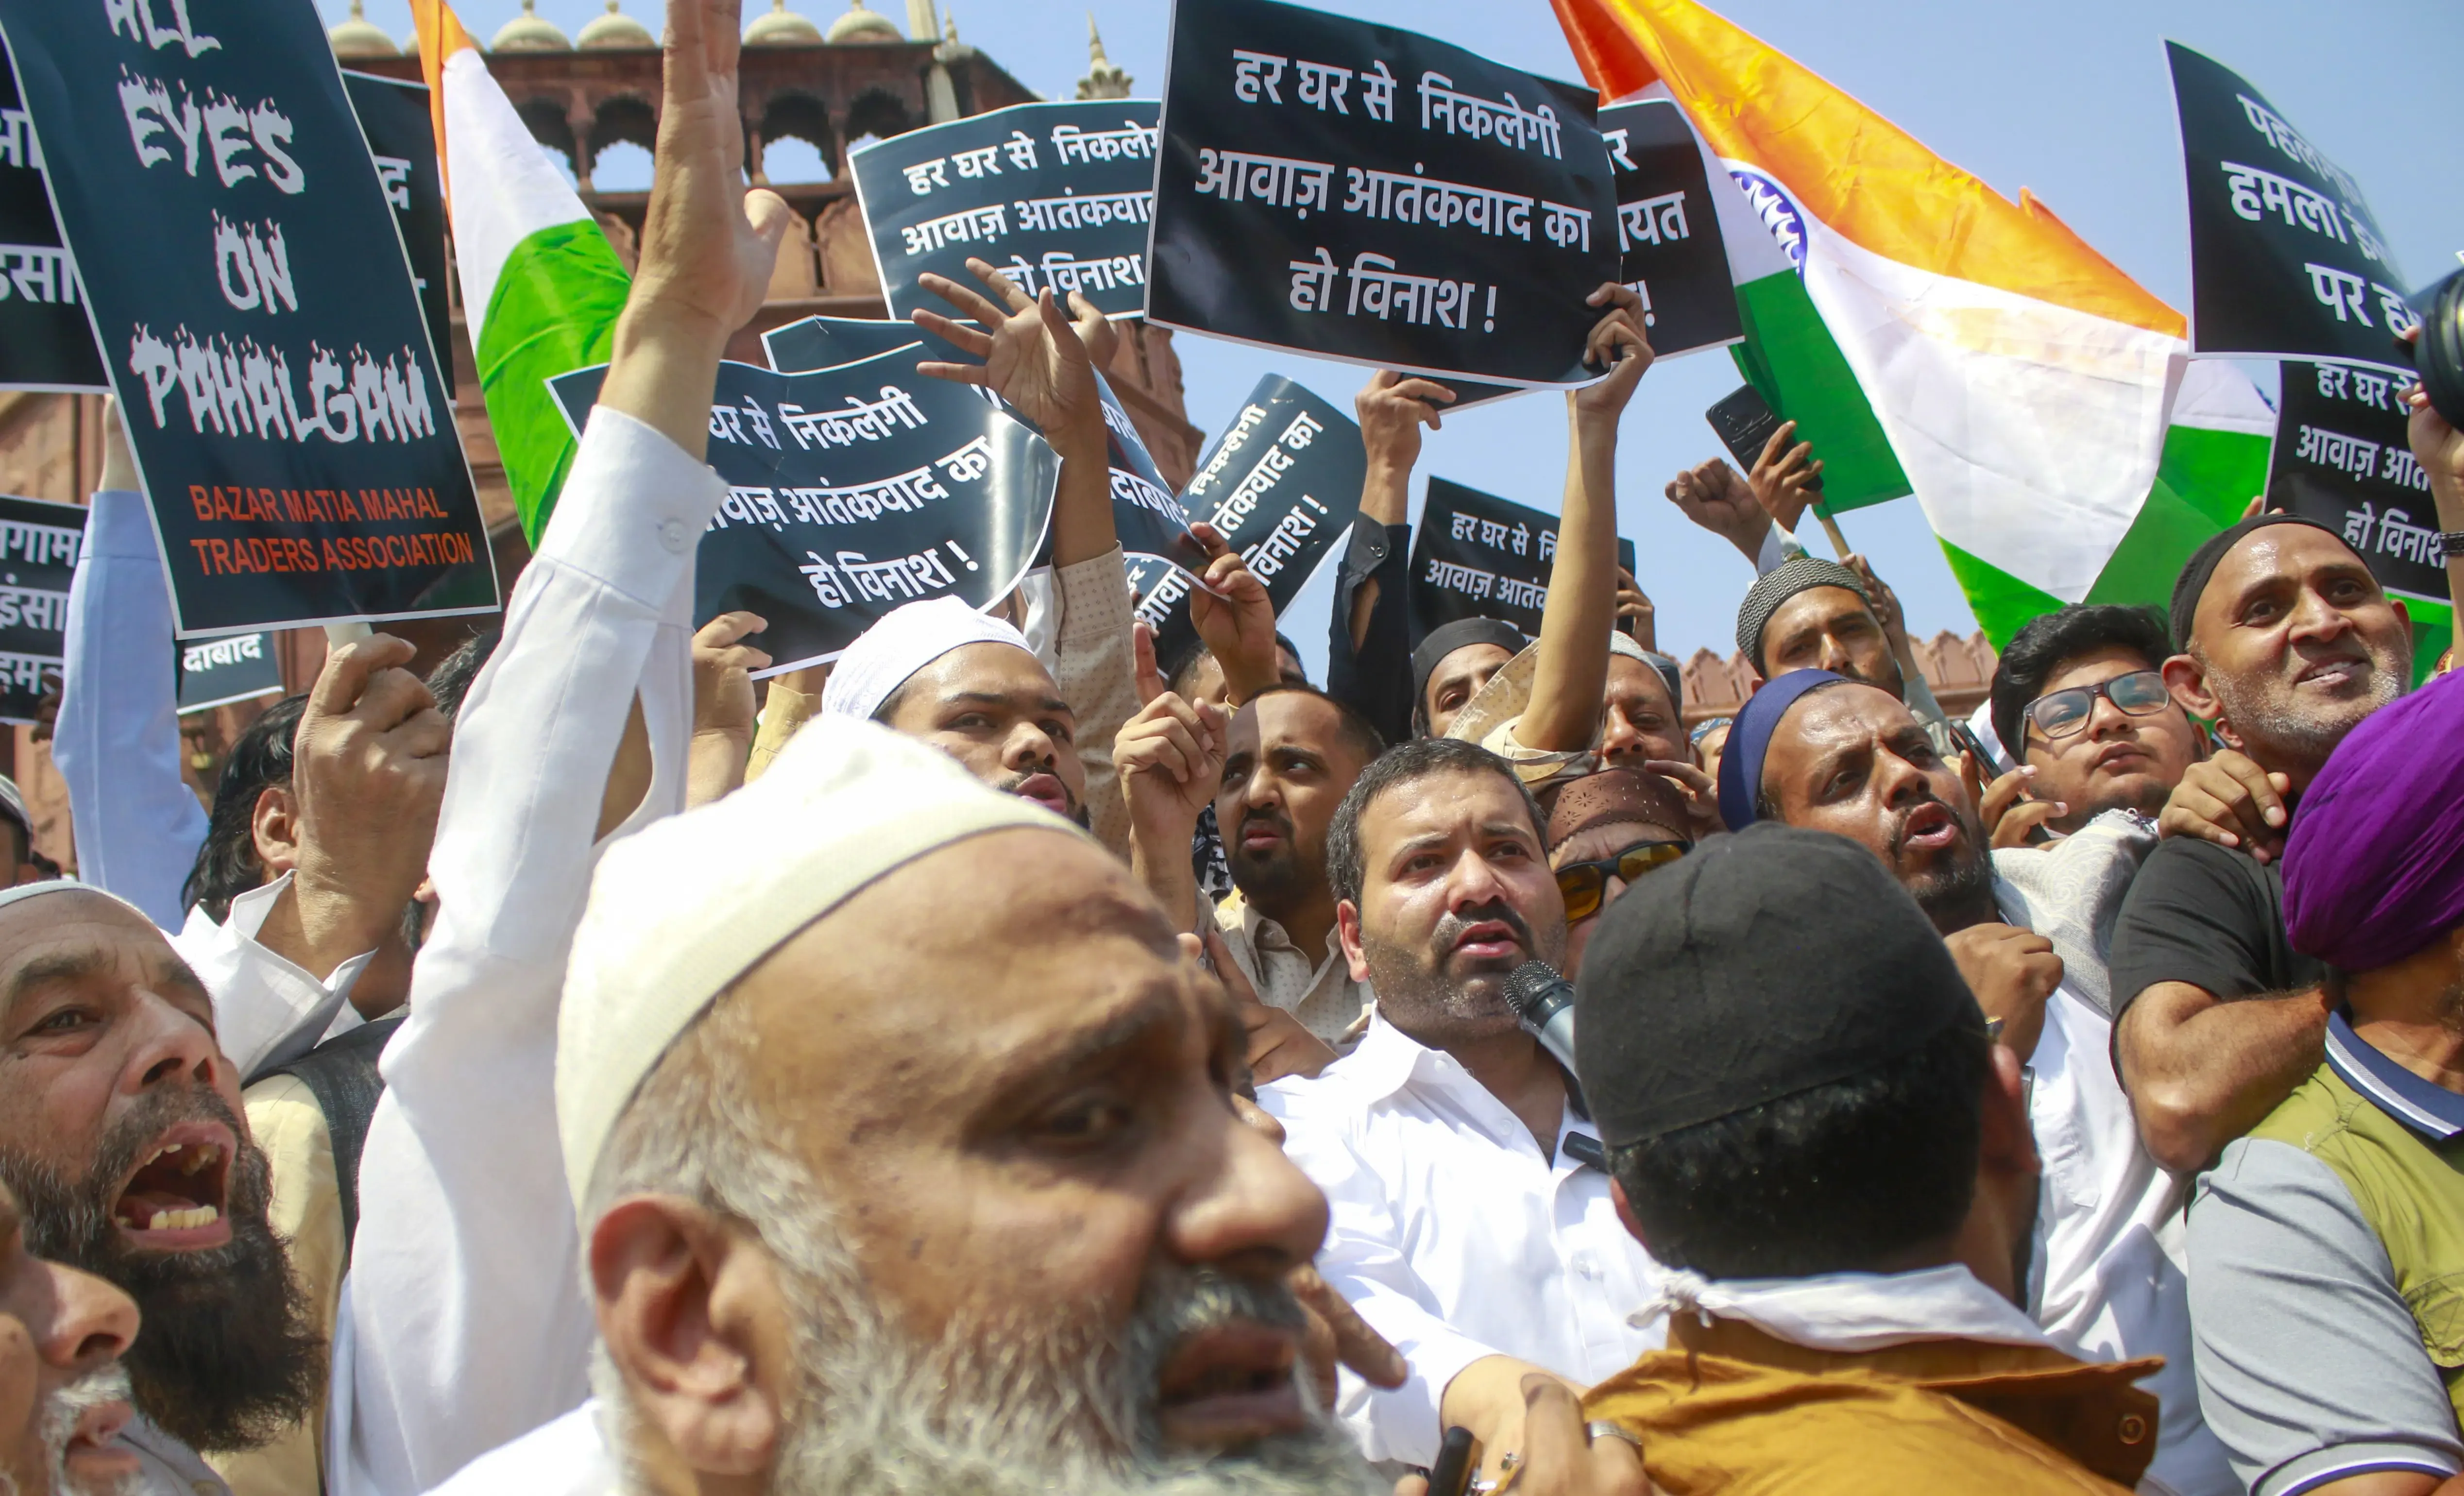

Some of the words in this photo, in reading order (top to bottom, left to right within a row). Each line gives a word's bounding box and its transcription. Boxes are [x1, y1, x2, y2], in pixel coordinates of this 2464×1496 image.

[118, 63, 305, 194] EYES
[1233, 49, 1287, 104] हर
[1296, 60, 1352, 115] घर
[1361, 60, 1397, 122] से
[1417, 71, 1563, 160] निकलेगी
[903, 158, 950, 195] हर
[952, 146, 1002, 179] घर
[1003, 131, 1038, 170] से
[901, 204, 1008, 255] आवाज़
[1014, 187, 1153, 231] आतंकवा
[1195, 148, 1335, 220] आवाज़
[1343, 162, 1534, 242] आतंकवाद
[1541, 199, 1592, 253] का
[2221, 161, 2348, 244] हमला
[211, 209, 298, 314] ON
[1040, 252, 1145, 295] विनाश
[1289, 247, 1339, 312] हो
[1347, 252, 1475, 329] विनाश
[2304, 263, 2374, 328] पर
[129, 323, 435, 443] PAHALGAM
[2314, 362, 2349, 400] हर
[2353, 372, 2388, 411] घर
[741, 395, 782, 450] से
[777, 385, 928, 450] निकलेगी
[1189, 403, 1267, 496] निकलेगी
[1278, 410, 1324, 450] का
[781, 465, 950, 526] आतंकवाद
[935, 435, 996, 482] का
[2296, 424, 2379, 483] आवाज़
[189, 485, 284, 521] BAZAR
[281, 490, 361, 522] MATIA
[359, 489, 448, 521] MAHAL
[1452, 511, 1478, 542] हर
[1481, 519, 1509, 551] घर
[1512, 522, 1530, 556] से
[191, 538, 319, 575] TRADERS
[323, 532, 474, 572] ASSOCIATION
[799, 550, 853, 608] हो
[835, 548, 957, 602] विनाश
[1425, 559, 1495, 601] आवाज़
